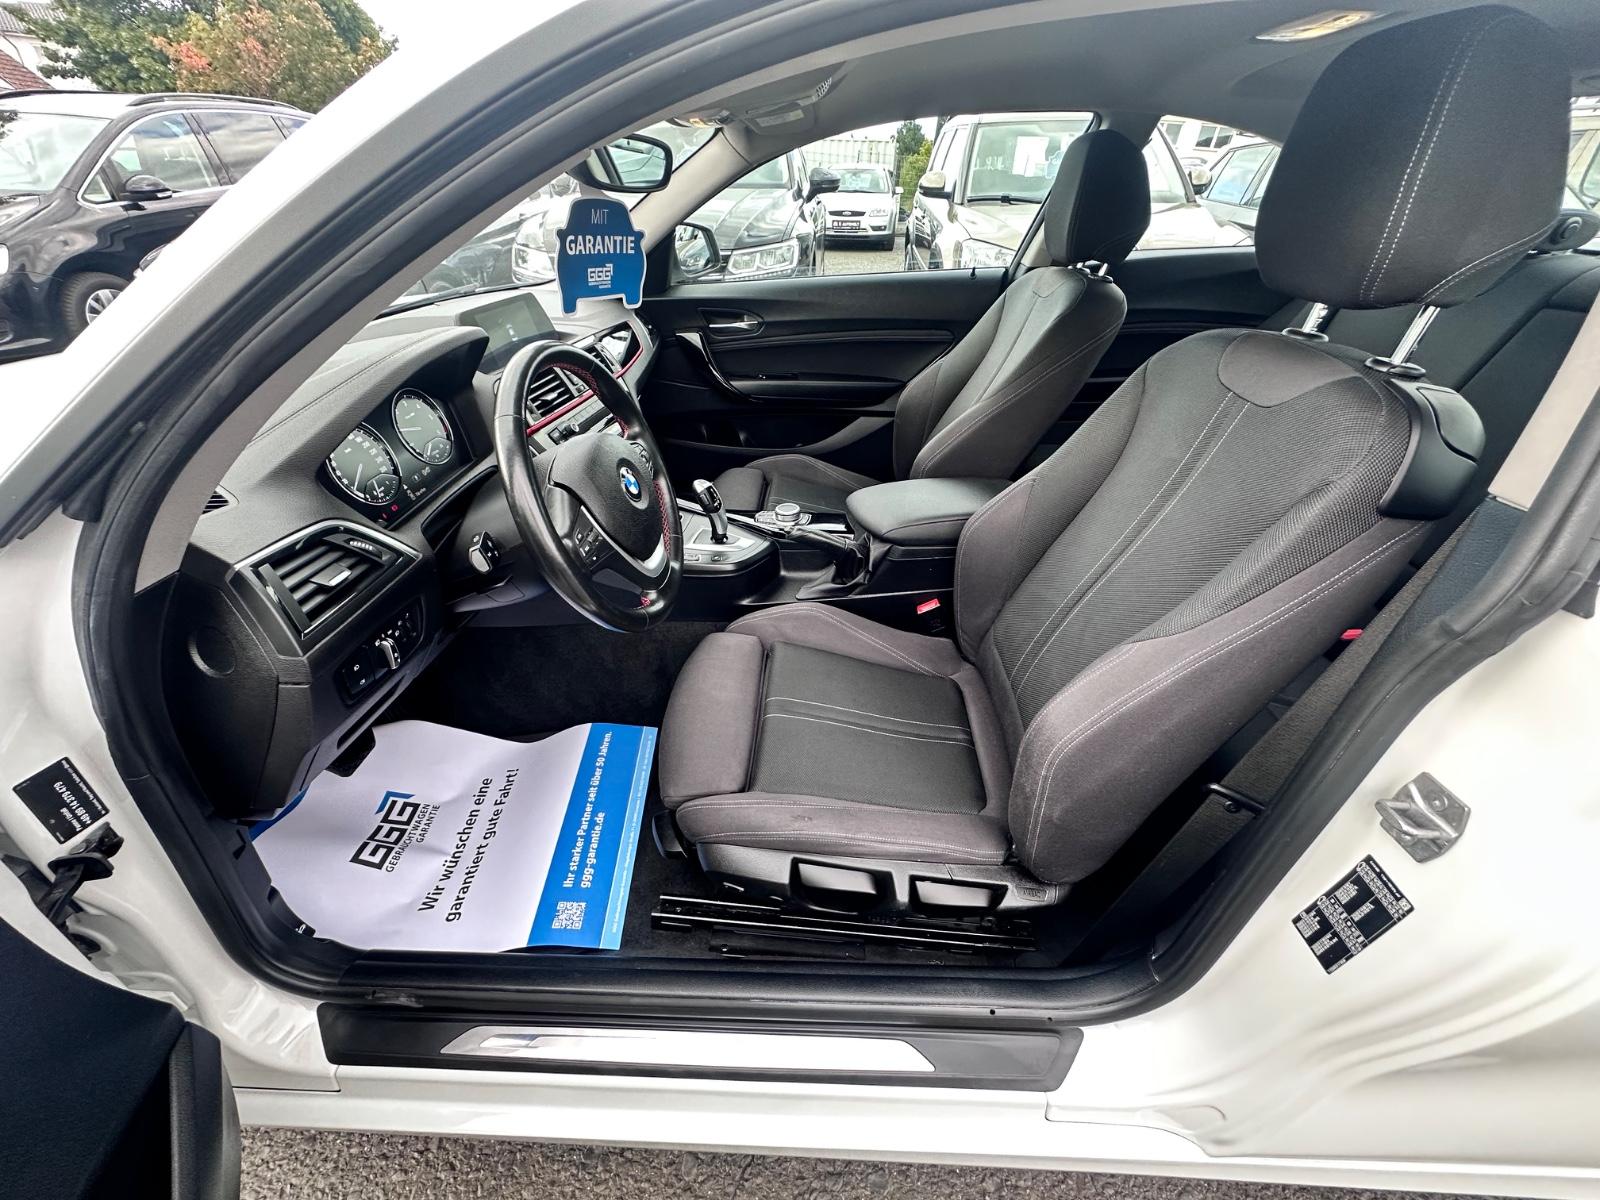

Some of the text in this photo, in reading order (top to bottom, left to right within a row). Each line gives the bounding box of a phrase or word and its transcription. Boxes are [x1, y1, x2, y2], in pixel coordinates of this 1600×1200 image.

[565, 234, 636, 256] GARANTIE
[591, 208, 609, 225] MIT
[587, 267, 612, 281] GGG
[349, 799, 421, 870] GGG
[385, 803, 431, 873] GEBRAUCHTWAGEN
[416, 804, 441, 843] GARANTIE
[417, 777, 493, 912] Wir wünschen eine
[562, 731, 613, 888] Ihr starker Partner seit über 50 Jahren.
[445, 768, 519, 922] garantiert gute Fahrt!
[580, 811, 605, 889] ggg-garantie.de
